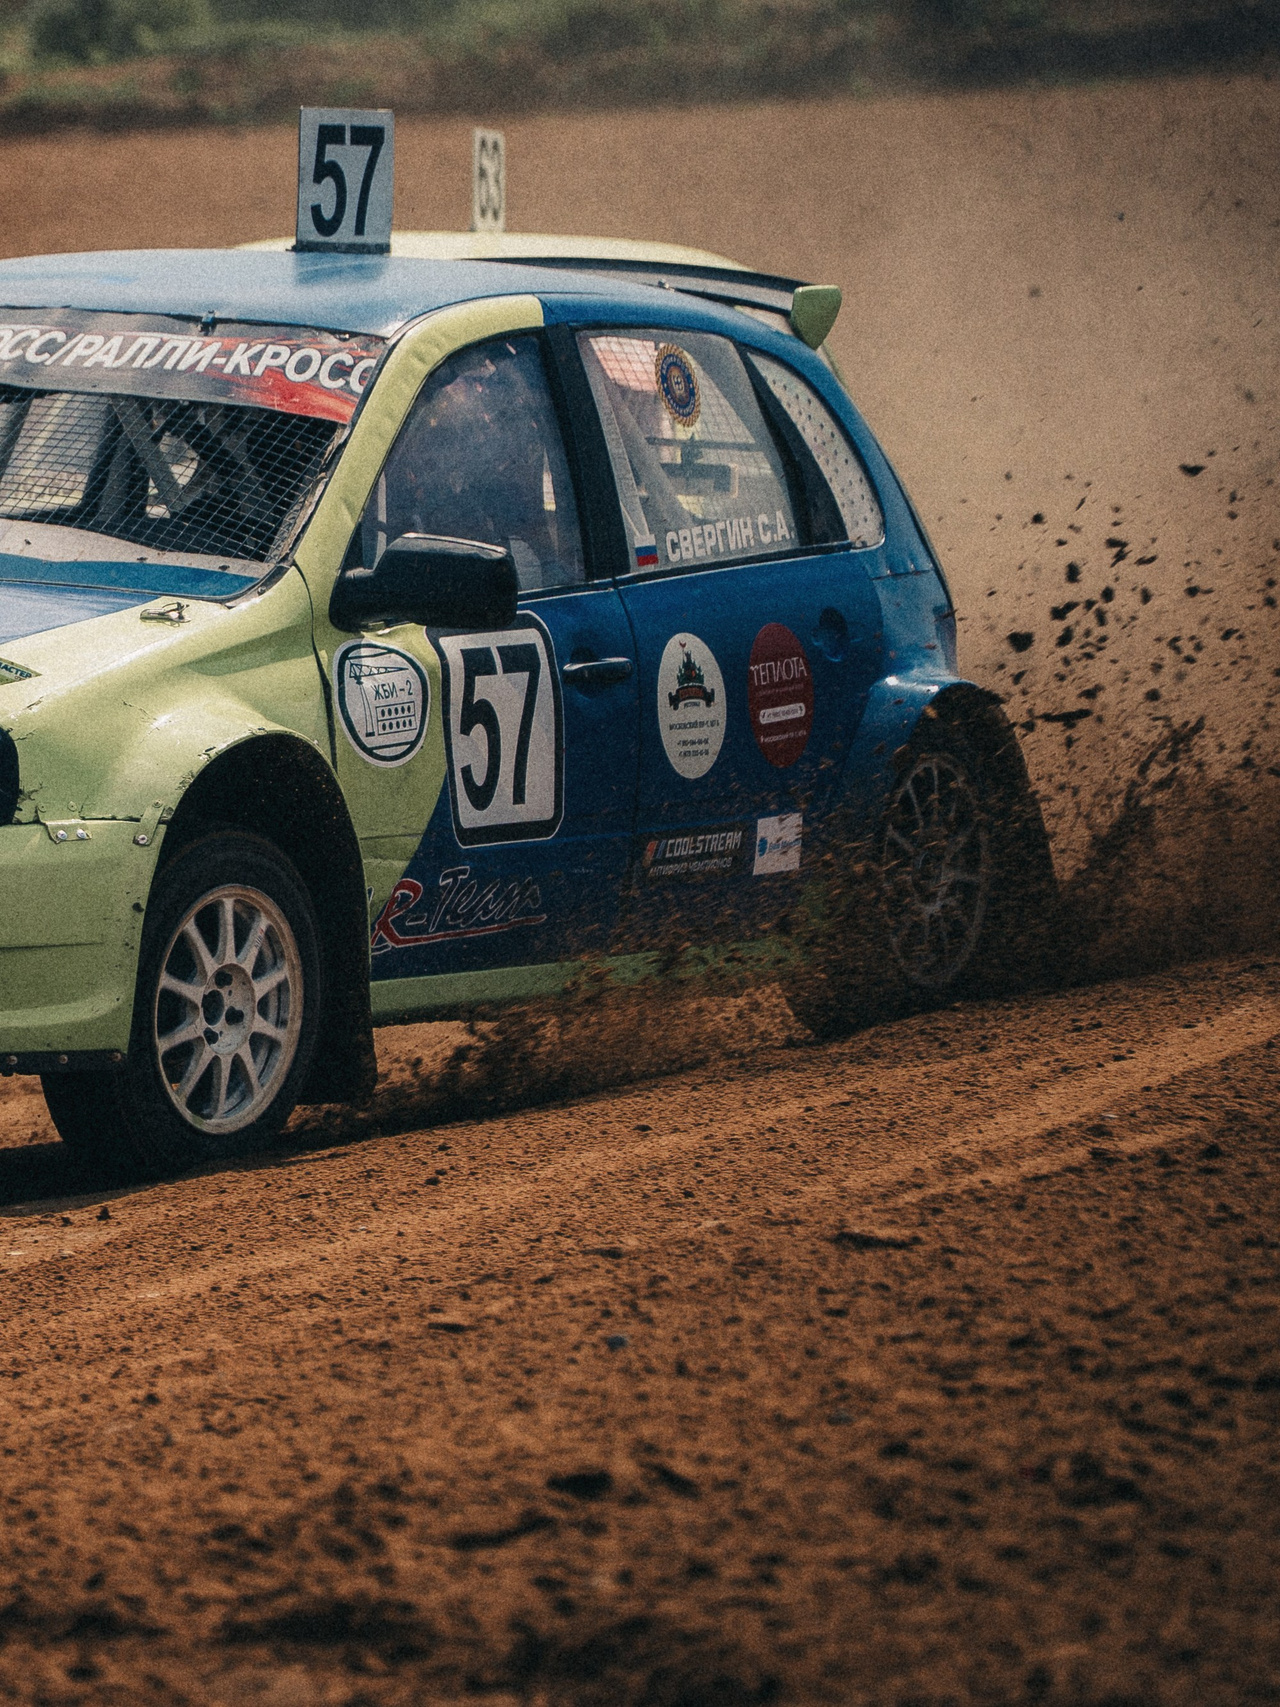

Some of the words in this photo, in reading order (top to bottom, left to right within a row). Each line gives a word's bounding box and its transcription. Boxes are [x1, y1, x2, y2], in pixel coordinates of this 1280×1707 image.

[310, 123, 385, 236] 57
[665, 517, 754, 562] СВЕРГИН
[749, 656, 808, 687] ТЕПЛОТА
[459, 642, 542, 812] 57
[665, 830, 743, 858] COOLSTREAM
